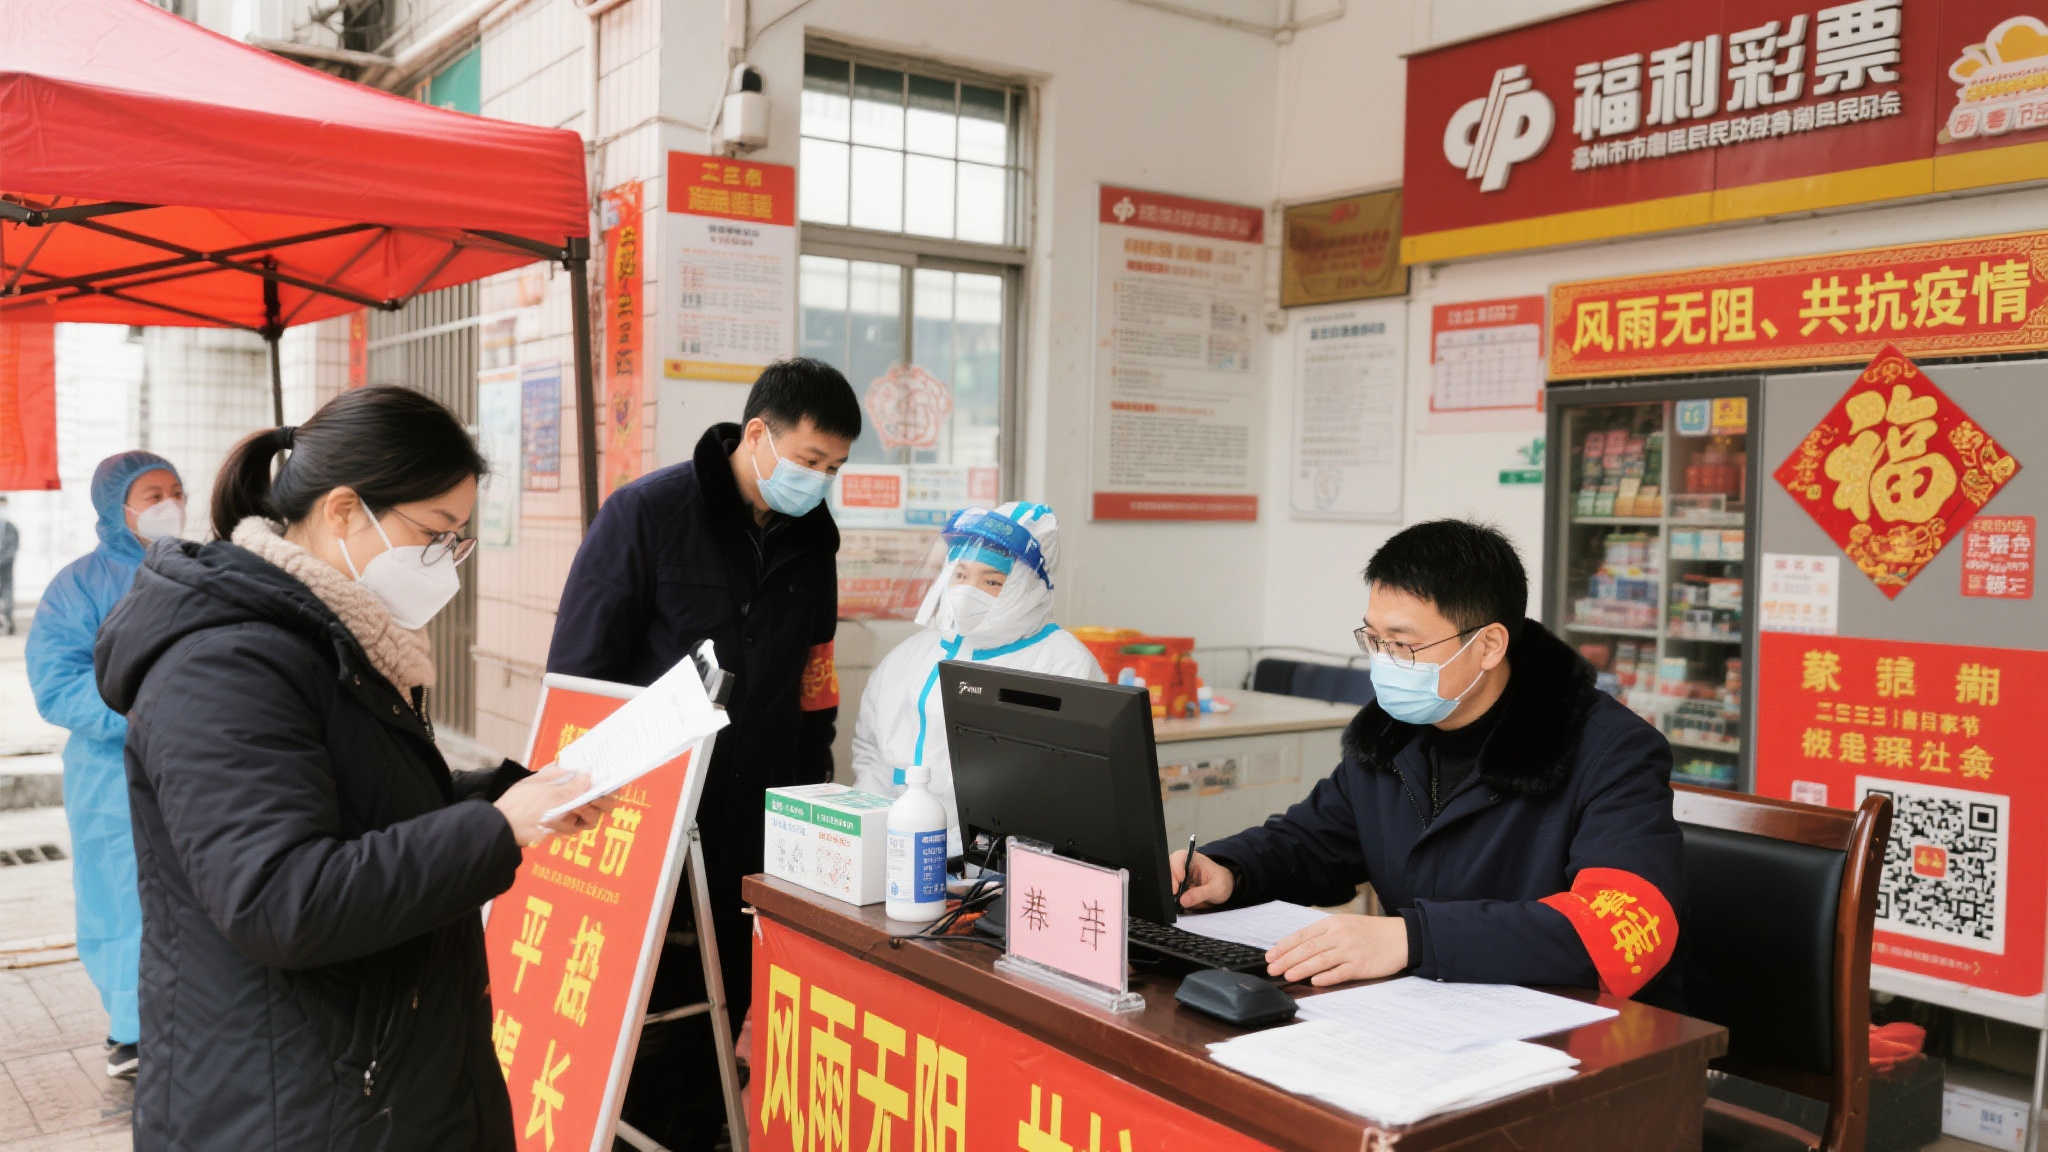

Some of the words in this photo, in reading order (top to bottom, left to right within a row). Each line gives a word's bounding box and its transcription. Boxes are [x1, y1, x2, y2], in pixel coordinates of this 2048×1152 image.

[1573, 0, 1901, 141] 福利彩票
[1572, 260, 2032, 353] 风雨无阻、共抗疫情
[1824, 384, 1957, 523] 福
